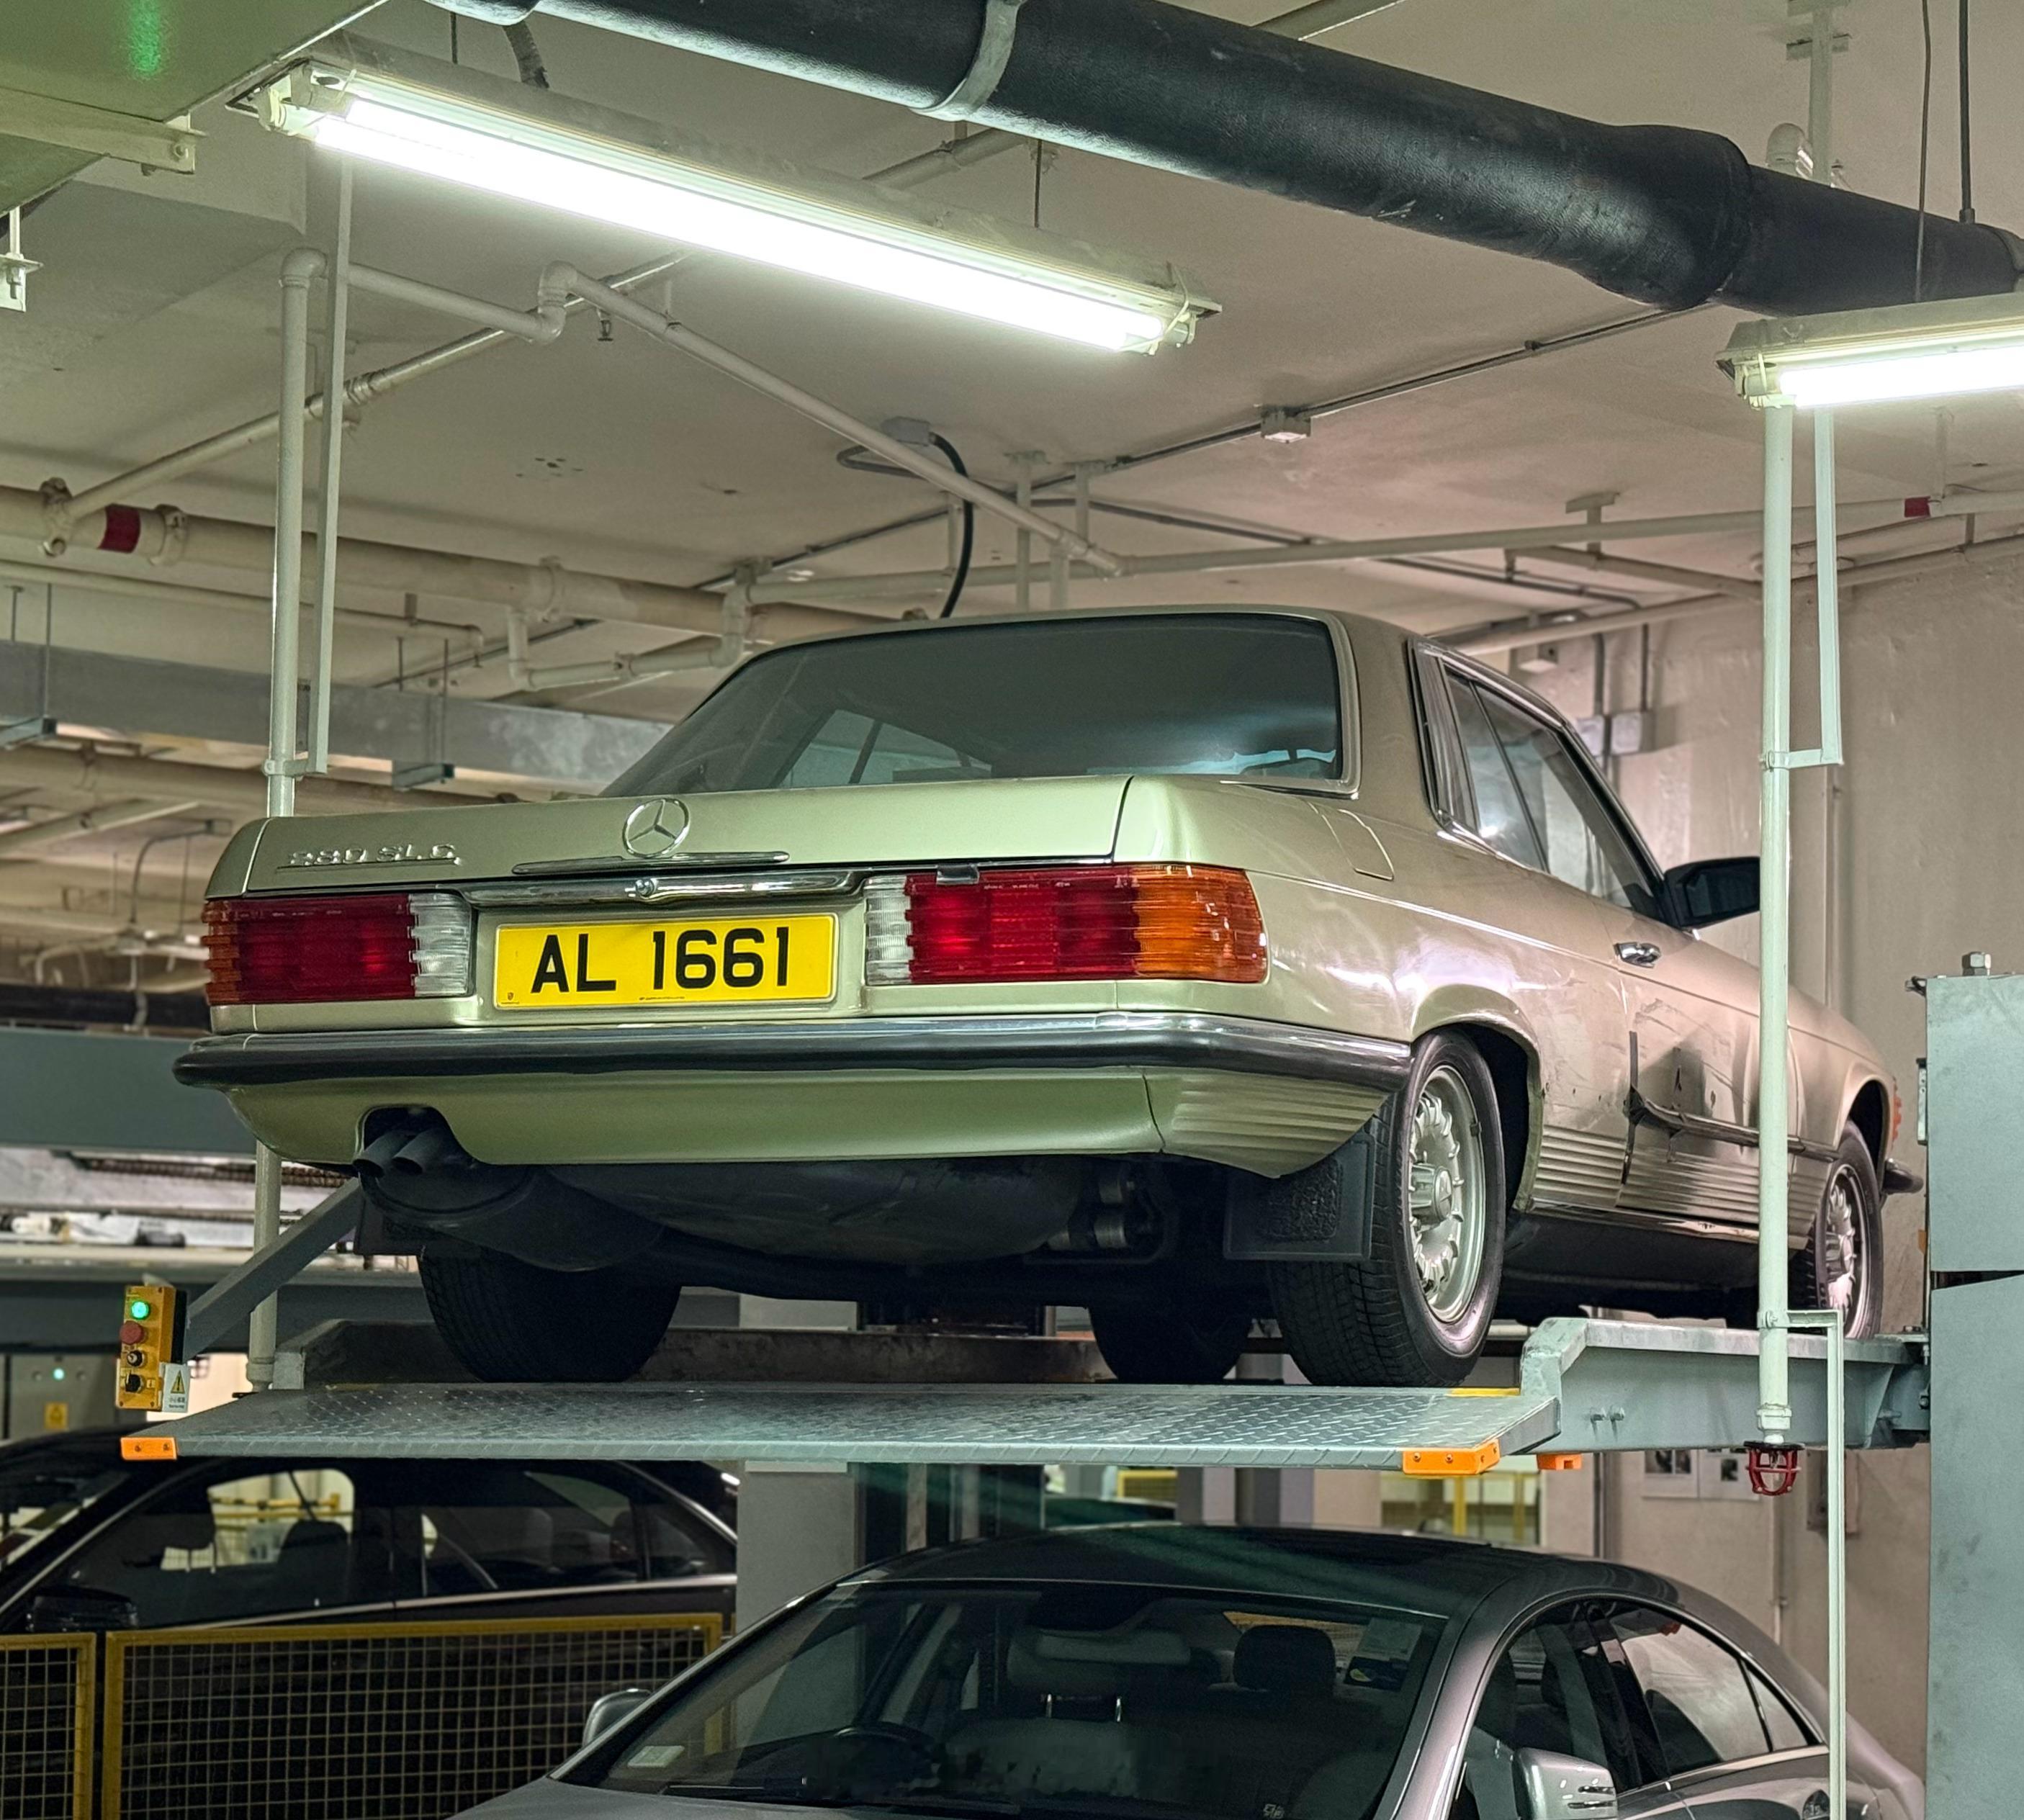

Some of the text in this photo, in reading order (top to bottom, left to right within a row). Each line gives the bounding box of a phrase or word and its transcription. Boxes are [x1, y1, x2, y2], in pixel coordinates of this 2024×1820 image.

[377, 843, 455, 862] SLC
[531, 927, 789, 994] AL 1661
